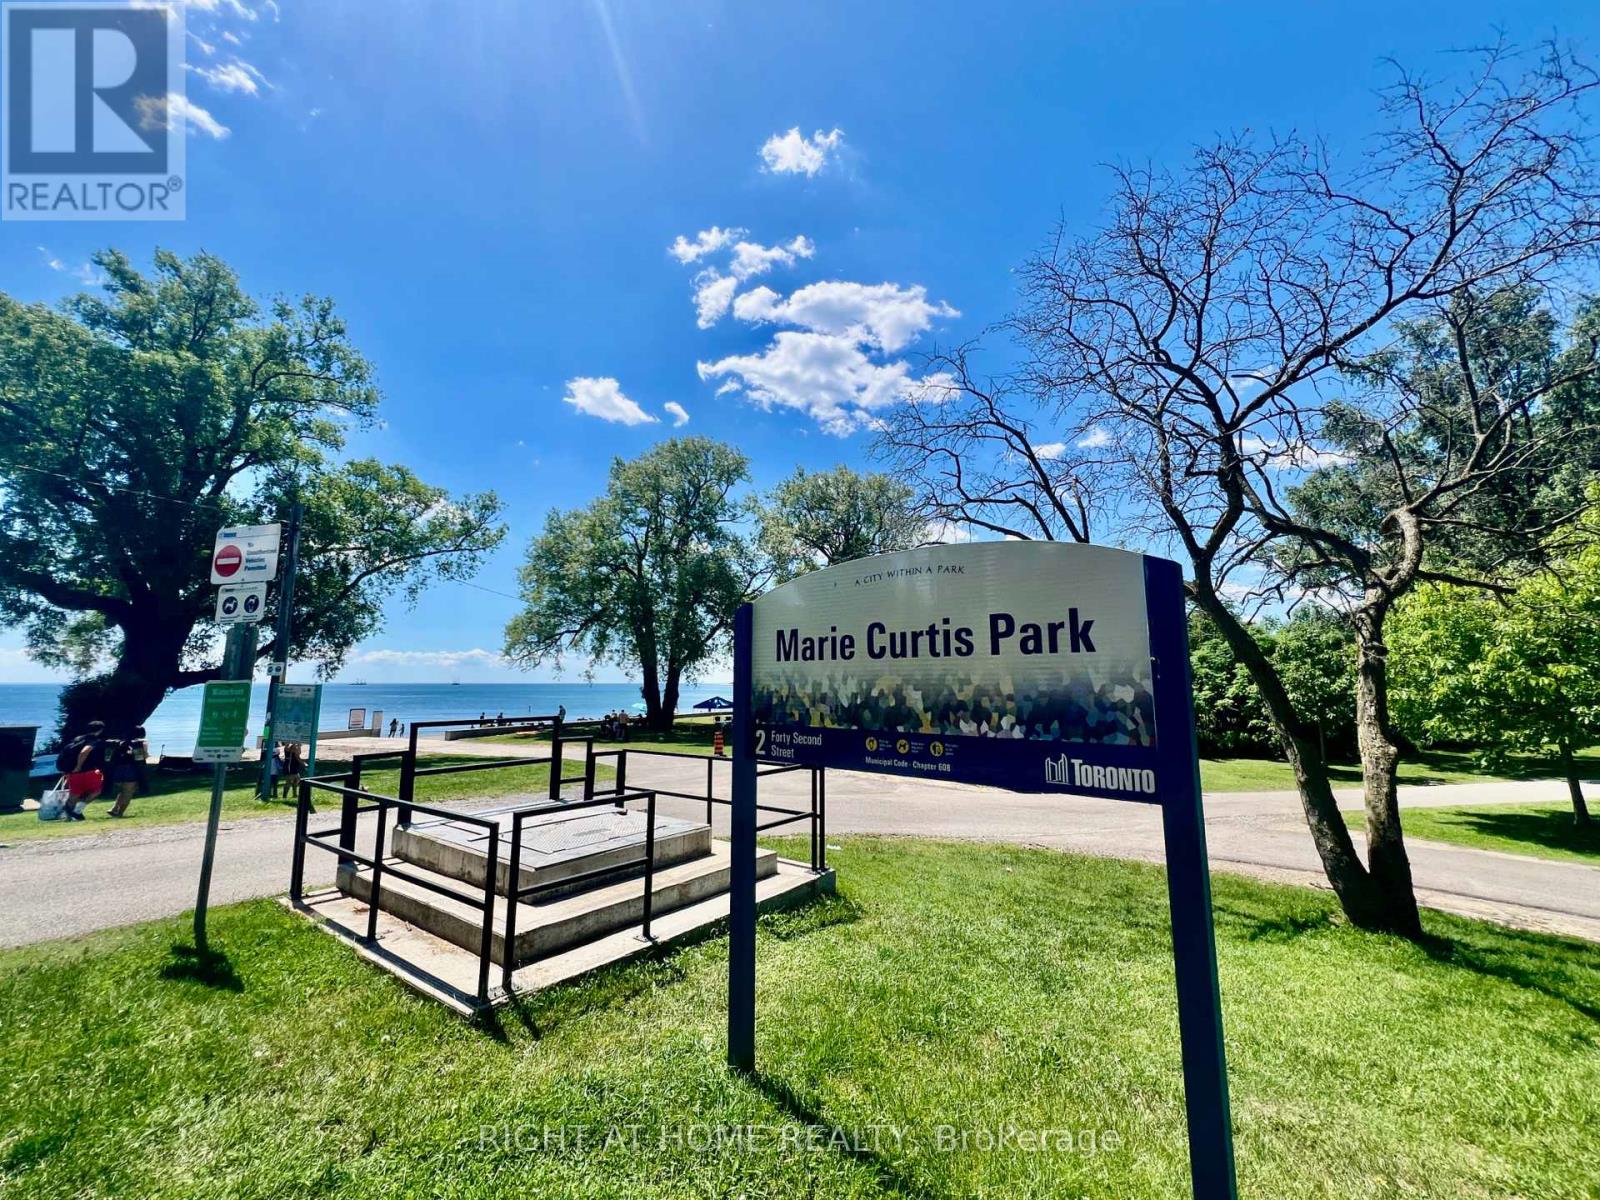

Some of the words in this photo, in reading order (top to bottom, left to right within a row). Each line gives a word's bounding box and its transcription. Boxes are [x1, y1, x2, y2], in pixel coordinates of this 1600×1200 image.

[855, 578, 862, 587] A
[863, 573, 883, 584] CITY
[887, 567, 922, 580] WITHIN
[926, 564, 933, 575] A
[937, 565, 966, 575] PARK
[776, 626, 855, 662] Marie
[866, 618, 975, 660] Curtis
[989, 607, 1097, 656] Park
[755, 729, 766, 755] 2
[771, 730, 791, 745] Forty
[792, 731, 823, 746] Second
[771, 744, 795, 758] Street
[865, 756, 893, 767] Municipal
[893, 759, 908, 768] Code
[912, 760, 937, 771] Chapter
[1070, 758, 1156, 794] TORONTO
